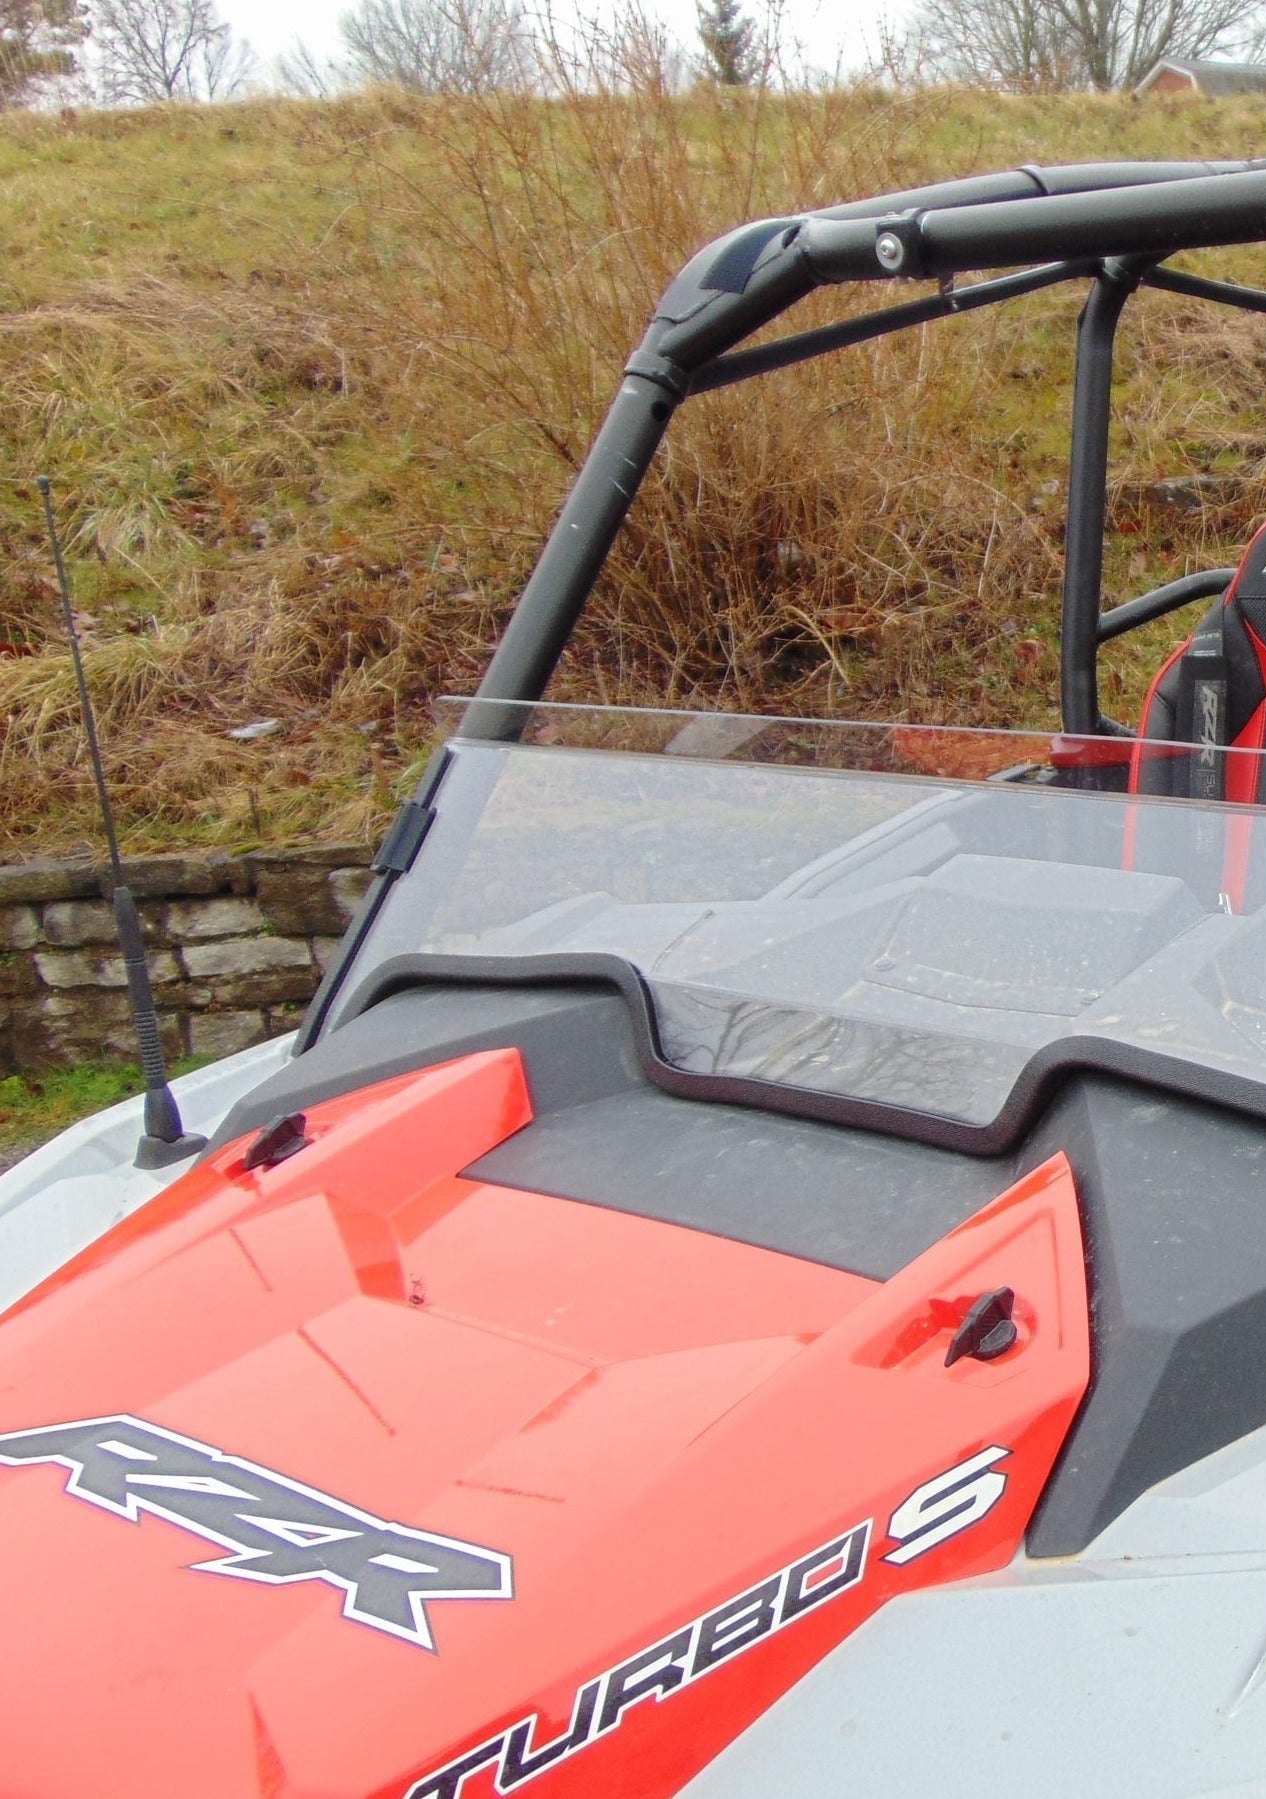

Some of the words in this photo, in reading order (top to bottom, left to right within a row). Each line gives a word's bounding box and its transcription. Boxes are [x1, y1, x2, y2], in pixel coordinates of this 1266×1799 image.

[0, 1413, 516, 1655] RZR
[401, 1517, 874, 1799] TURBO
[879, 1444, 1014, 1567] S
